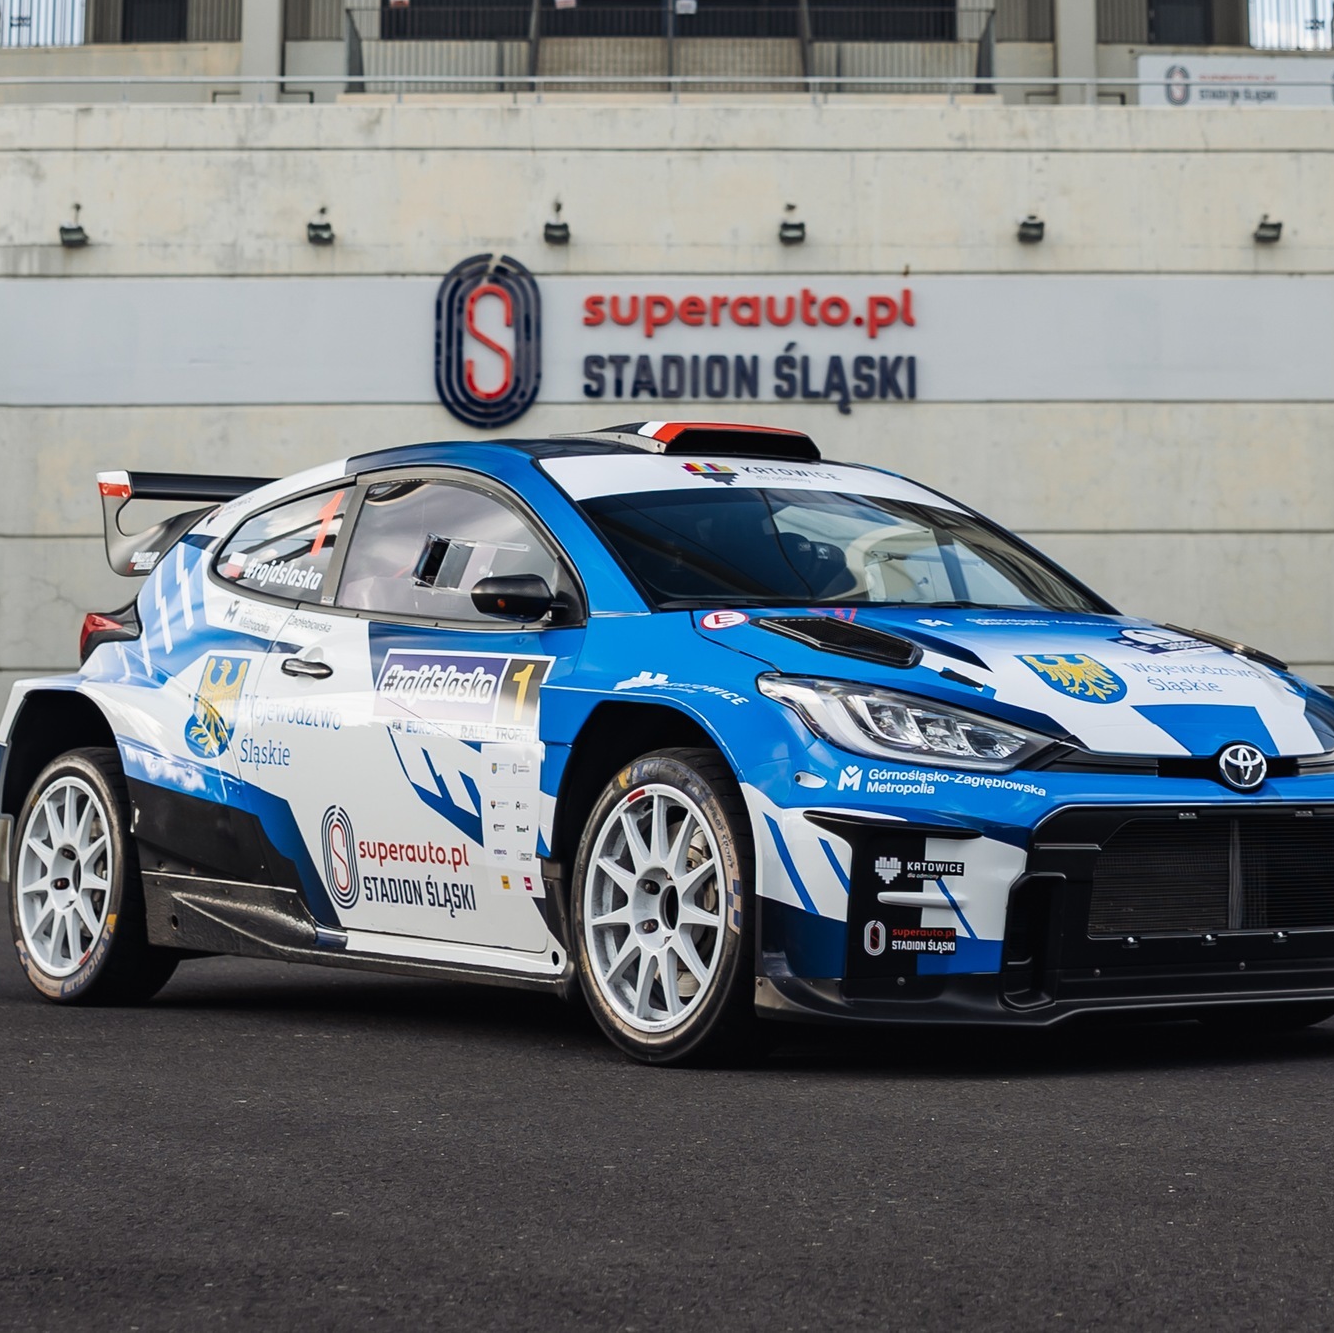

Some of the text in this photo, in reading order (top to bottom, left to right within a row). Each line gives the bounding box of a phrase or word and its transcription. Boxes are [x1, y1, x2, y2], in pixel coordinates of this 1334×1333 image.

[582, 287, 916, 339] superauto.pl
[582, 341, 918, 415] STADION ŚLĄSKI
[740, 465, 843, 482] KATOWICE
[310, 490, 346, 557] 1
[243, 556, 324, 591] #rajdslaska
[382, 663, 536, 722] #rajdslaska 1
[1146, 676, 1224, 695] Śląskie
[239, 733, 291, 771] Śląskie
[866, 781, 935, 795] Metropolia
[868, 768, 1047, 797] Górnośląsko-Zagłębiowska
[358, 841, 470, 873] superauto.pl
[906, 861, 963, 873] KATOWICE
[363, 874, 477, 918] STADION ŚLĄSKI
[891, 927, 956, 939] superauto.pl
[891, 939, 956, 954] STADION ŚLĄSKI
